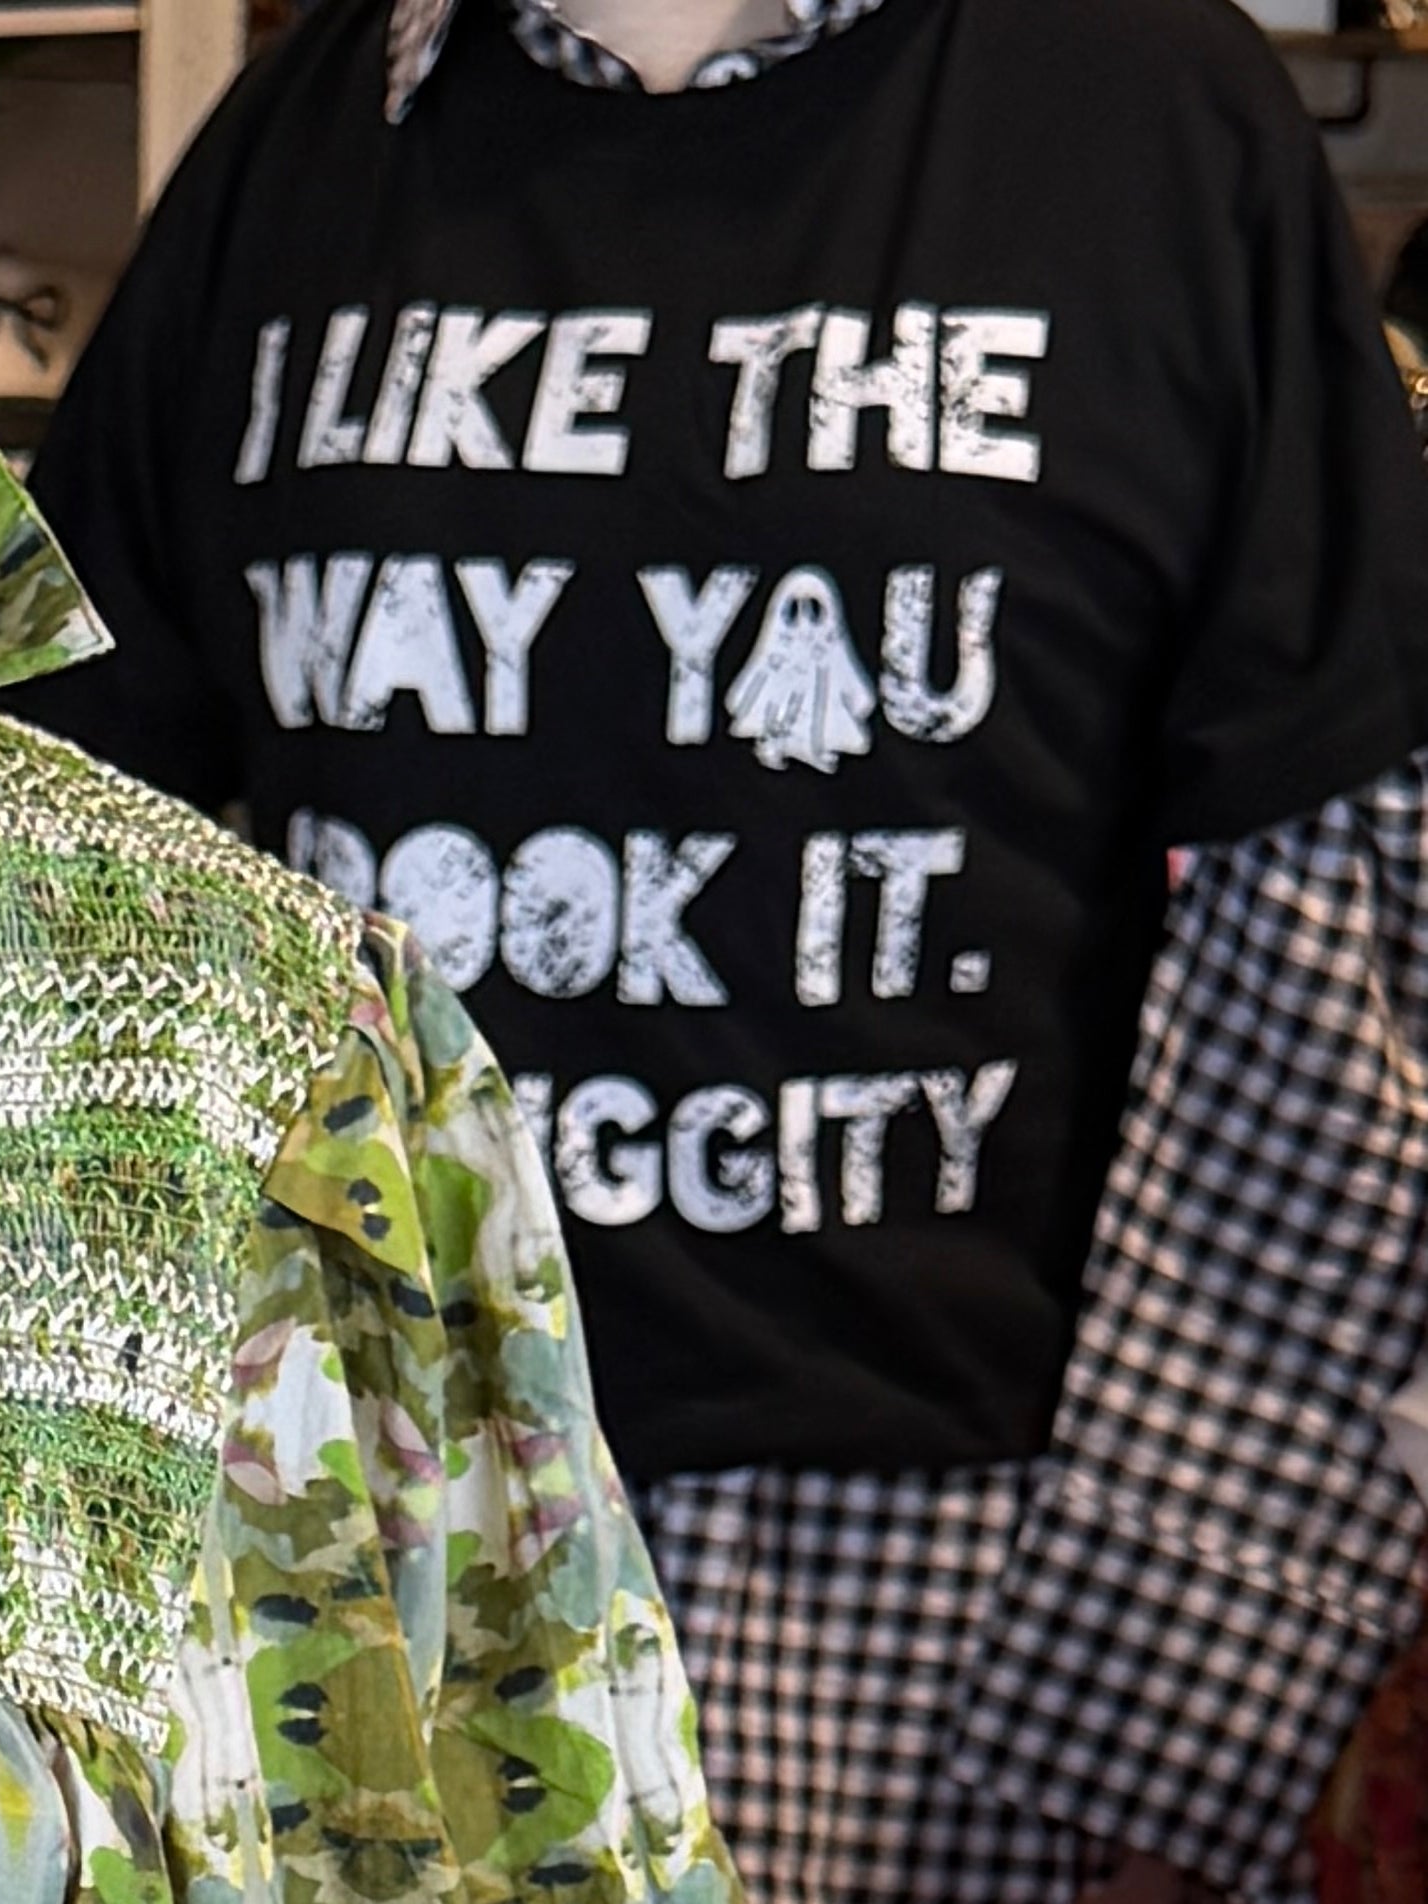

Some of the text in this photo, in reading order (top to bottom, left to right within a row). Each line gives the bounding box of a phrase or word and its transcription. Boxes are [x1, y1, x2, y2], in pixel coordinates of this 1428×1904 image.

[236, 303, 1051, 484] I LIKE THE
[245, 552, 576, 737] WAY
[794, 828, 991, 1008] IT.
